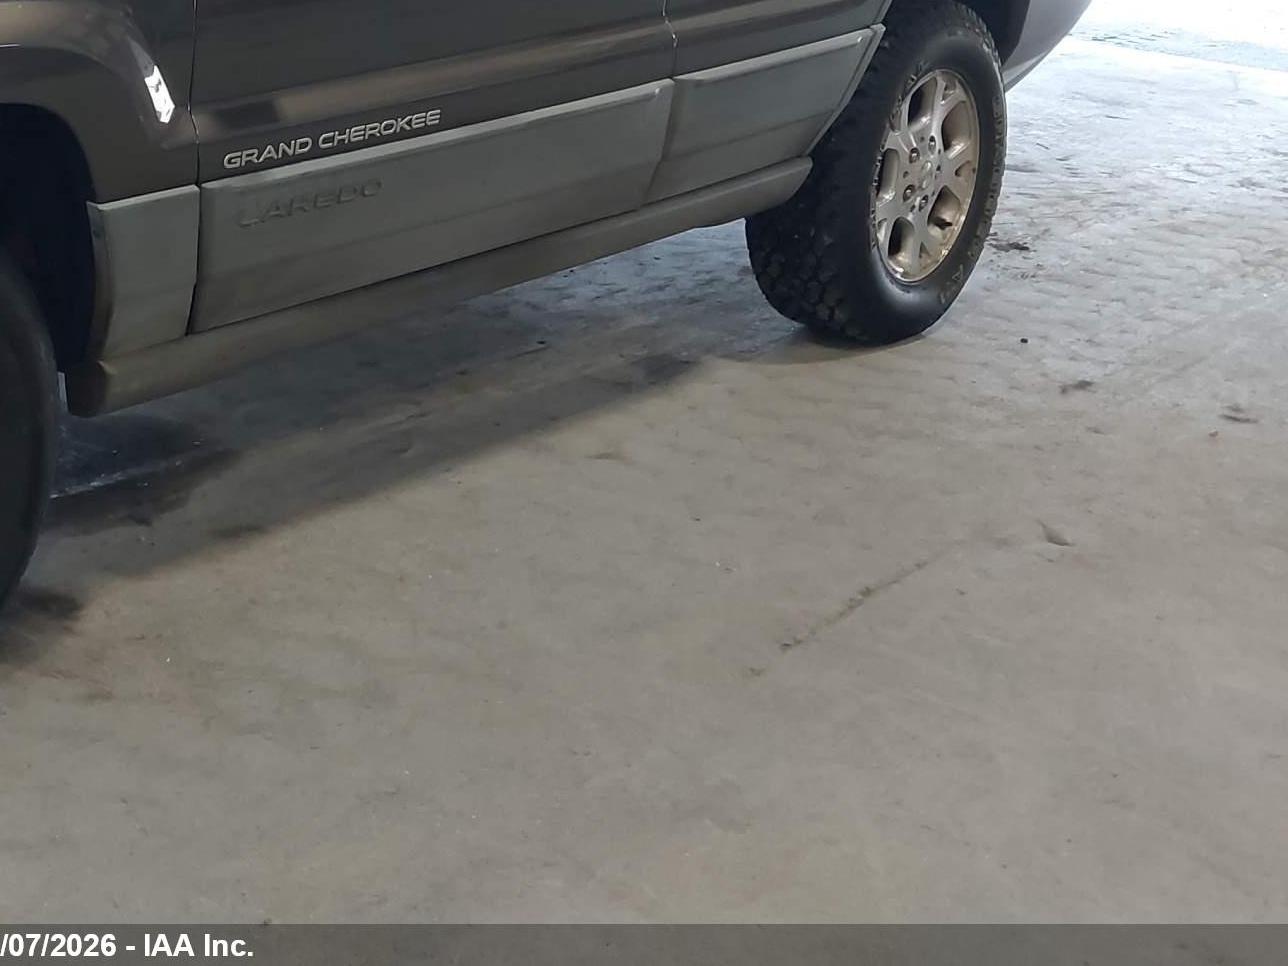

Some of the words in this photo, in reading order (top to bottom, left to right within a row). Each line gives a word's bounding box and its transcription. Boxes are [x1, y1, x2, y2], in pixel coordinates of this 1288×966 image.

[223, 137, 312, 169] GRAND
[318, 109, 441, 149] CHEROKEE
[237, 178, 383, 226] LAREDO
